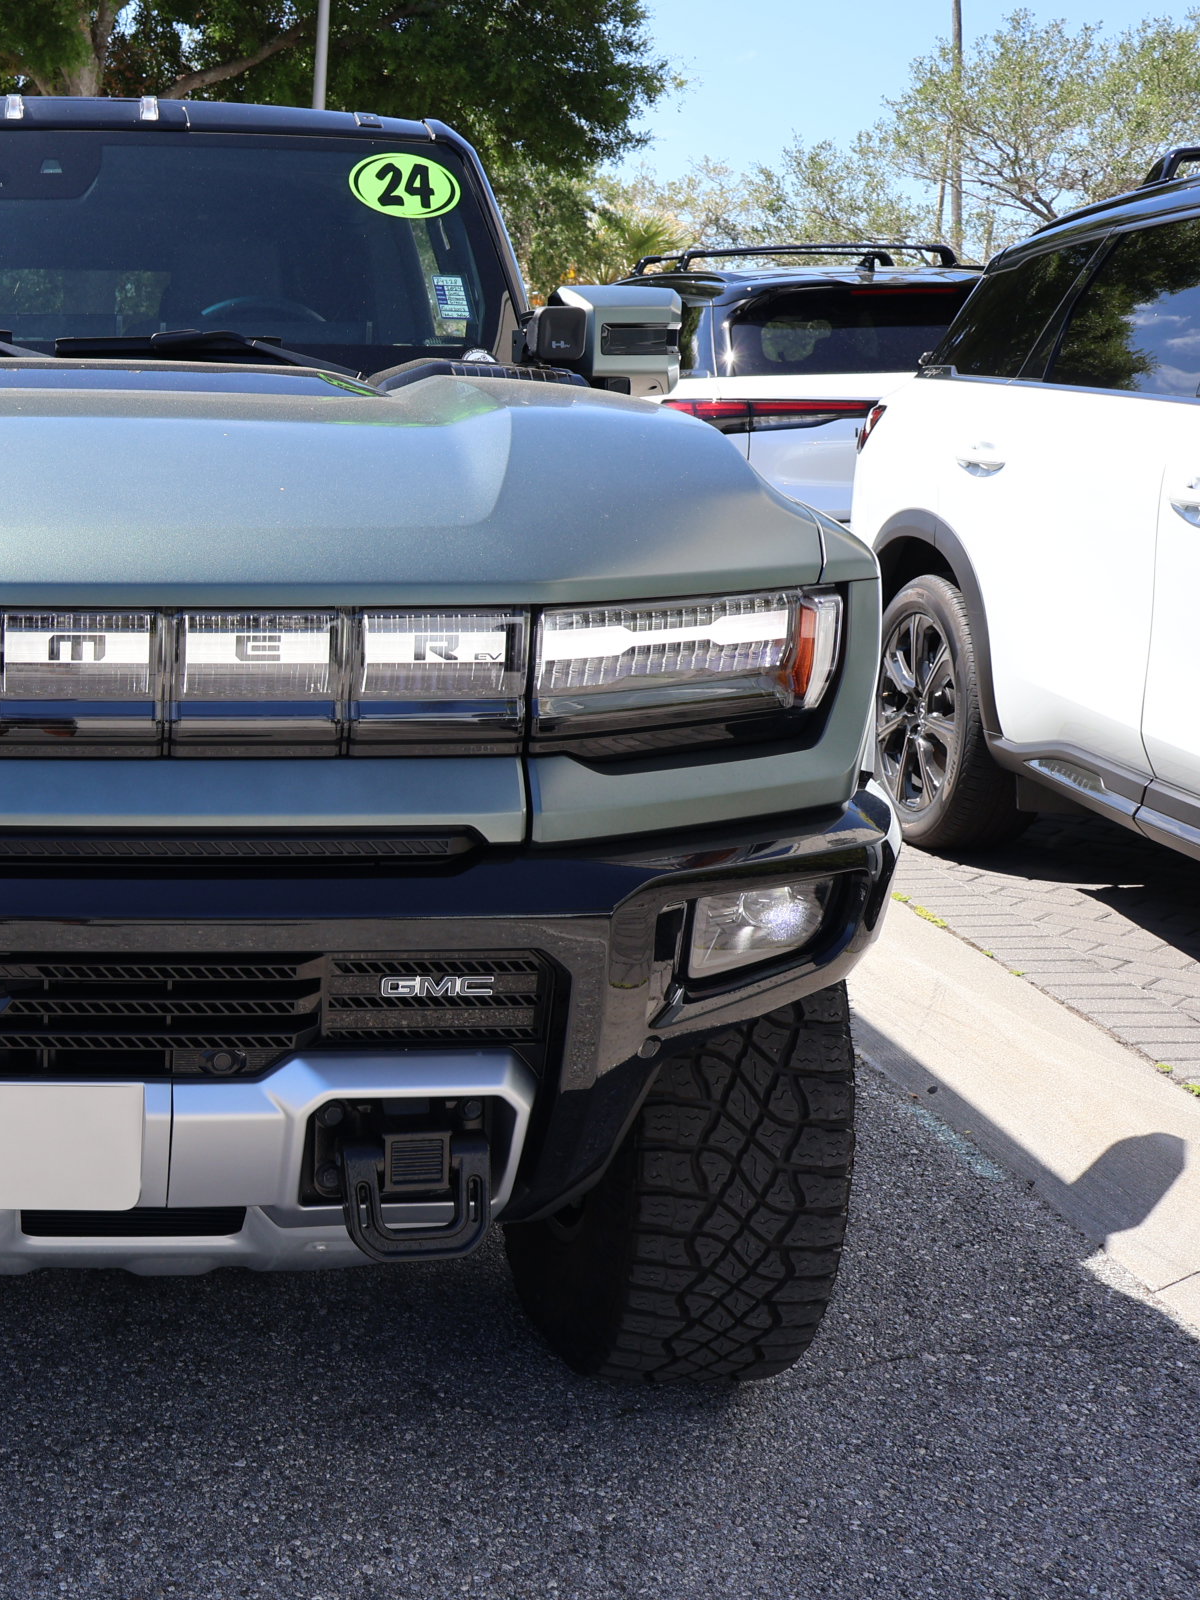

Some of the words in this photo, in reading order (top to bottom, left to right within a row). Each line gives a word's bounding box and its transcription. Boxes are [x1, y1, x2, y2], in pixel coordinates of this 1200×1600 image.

[375, 162, 435, 209] 24
[474, 652, 503, 661] EV
[381, 975, 495, 997] GMC
